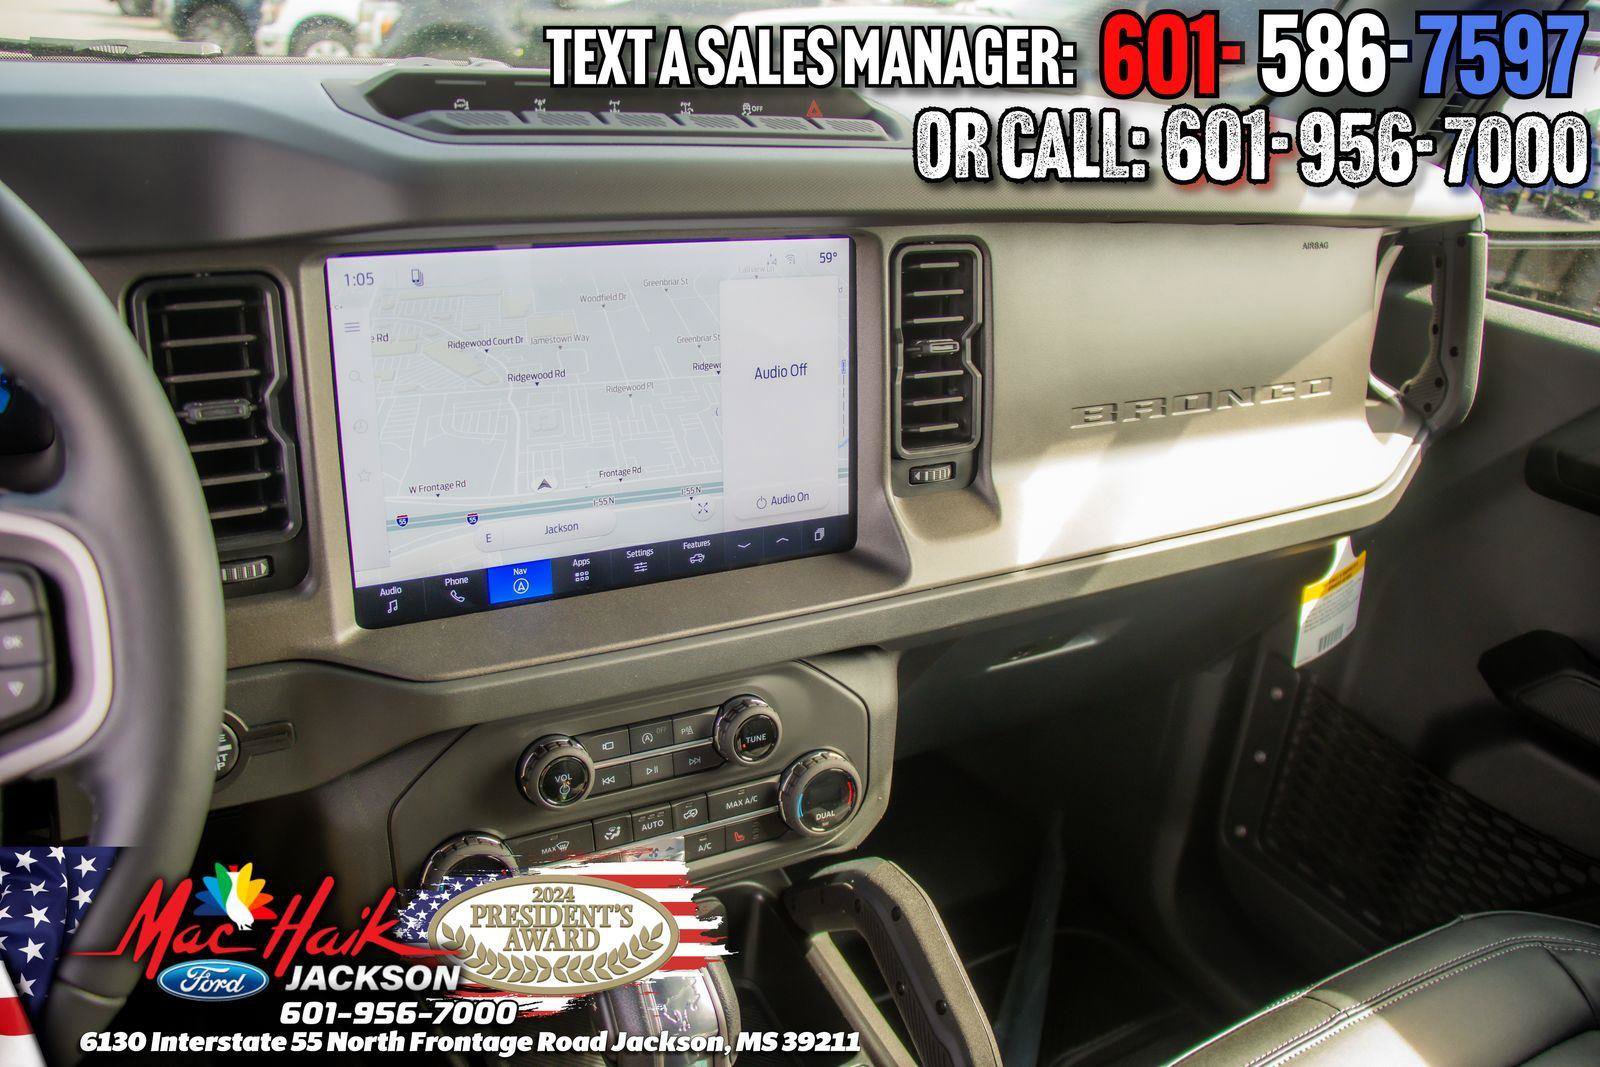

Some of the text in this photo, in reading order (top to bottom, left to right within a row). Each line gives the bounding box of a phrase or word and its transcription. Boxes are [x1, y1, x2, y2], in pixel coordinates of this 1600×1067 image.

[1302, 241, 1329, 250] AIRBAG
[818, 251, 838, 264] 59°
[343, 271, 375, 288] 1:05
[643, 277, 689, 288] Greenbriar St
[580, 292, 627, 303] Woodfield Dr
[376, 333, 389, 343] Rd
[447, 335, 524, 349] Ridgewood Court Dr
[530, 333, 590, 346] Jamestown Way
[676, 335, 712, 344] Greenbriar
[507, 368, 566, 383] Ridgewood Rd
[754, 362, 808, 380] Audio Off
[605, 381, 646, 394] Ridgewood
[1071, 377, 1332, 429] BRONCO
[599, 465, 642, 479] Frontage Rd
[409, 479, 466, 494] W Frontage Rd
[695, 485, 702, 494] N
[608, 496, 615, 504] N
[770, 491, 810, 506] Audio On
[544, 521, 579, 535] Jackson
[485, 533, 493, 543] E
[683, 539, 711, 551] Features
[626, 548, 654, 560] Settings
[572, 557, 591, 569] Apps
[512, 567, 528, 577] Nav
[444, 575, 469, 587] Phone
[379, 585, 402, 597] Audio
[745, 733, 767, 744] TUNE
[554, 774, 573, 783] VOL
[725, 795, 758, 810] MAX A/C
[815, 810, 836, 821] DUAL
[641, 819, 664, 832] AUTO
[541, 846, 556, 855] MAX
[698, 842, 712, 853] A/C
